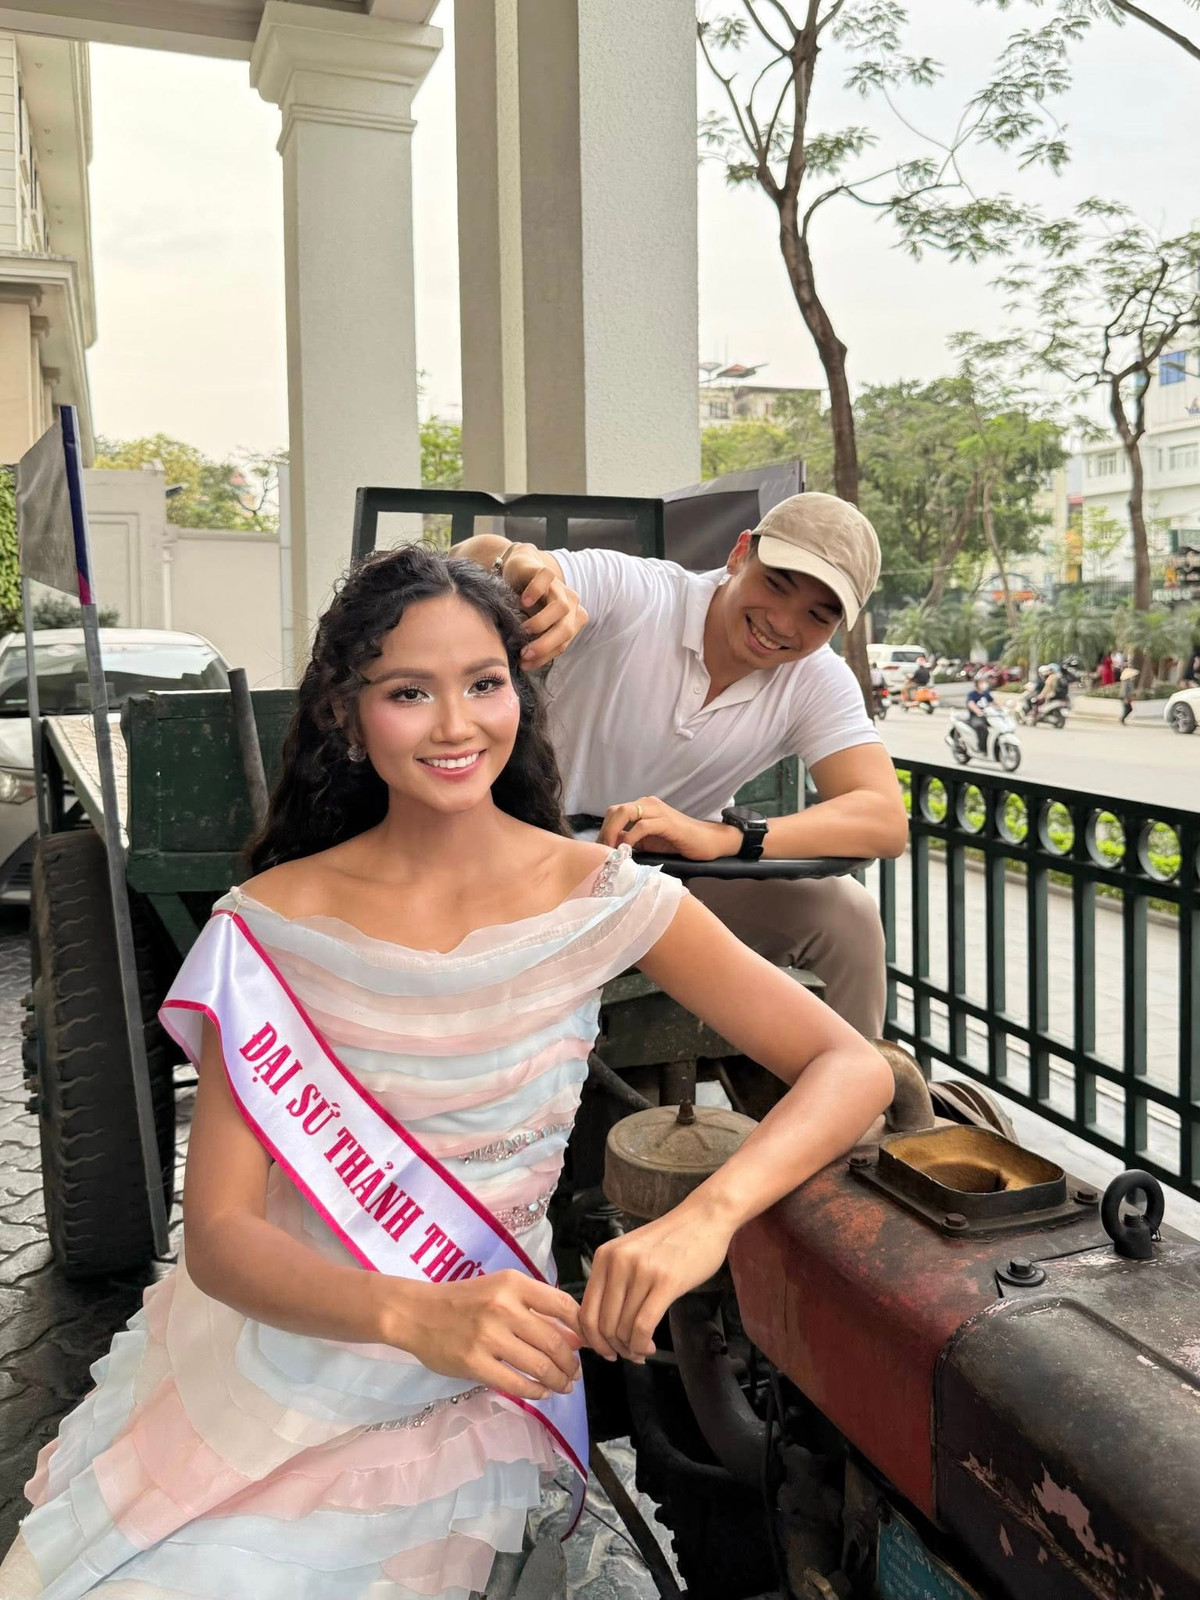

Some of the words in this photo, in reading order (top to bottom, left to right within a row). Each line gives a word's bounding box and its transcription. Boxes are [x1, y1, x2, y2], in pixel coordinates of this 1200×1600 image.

[239, 1021, 303, 1096] ĐẠI
[285, 1083, 341, 1136] SỨ
[323, 1126, 425, 1243] THẢNH
[409, 1222, 486, 1284] THƠ
